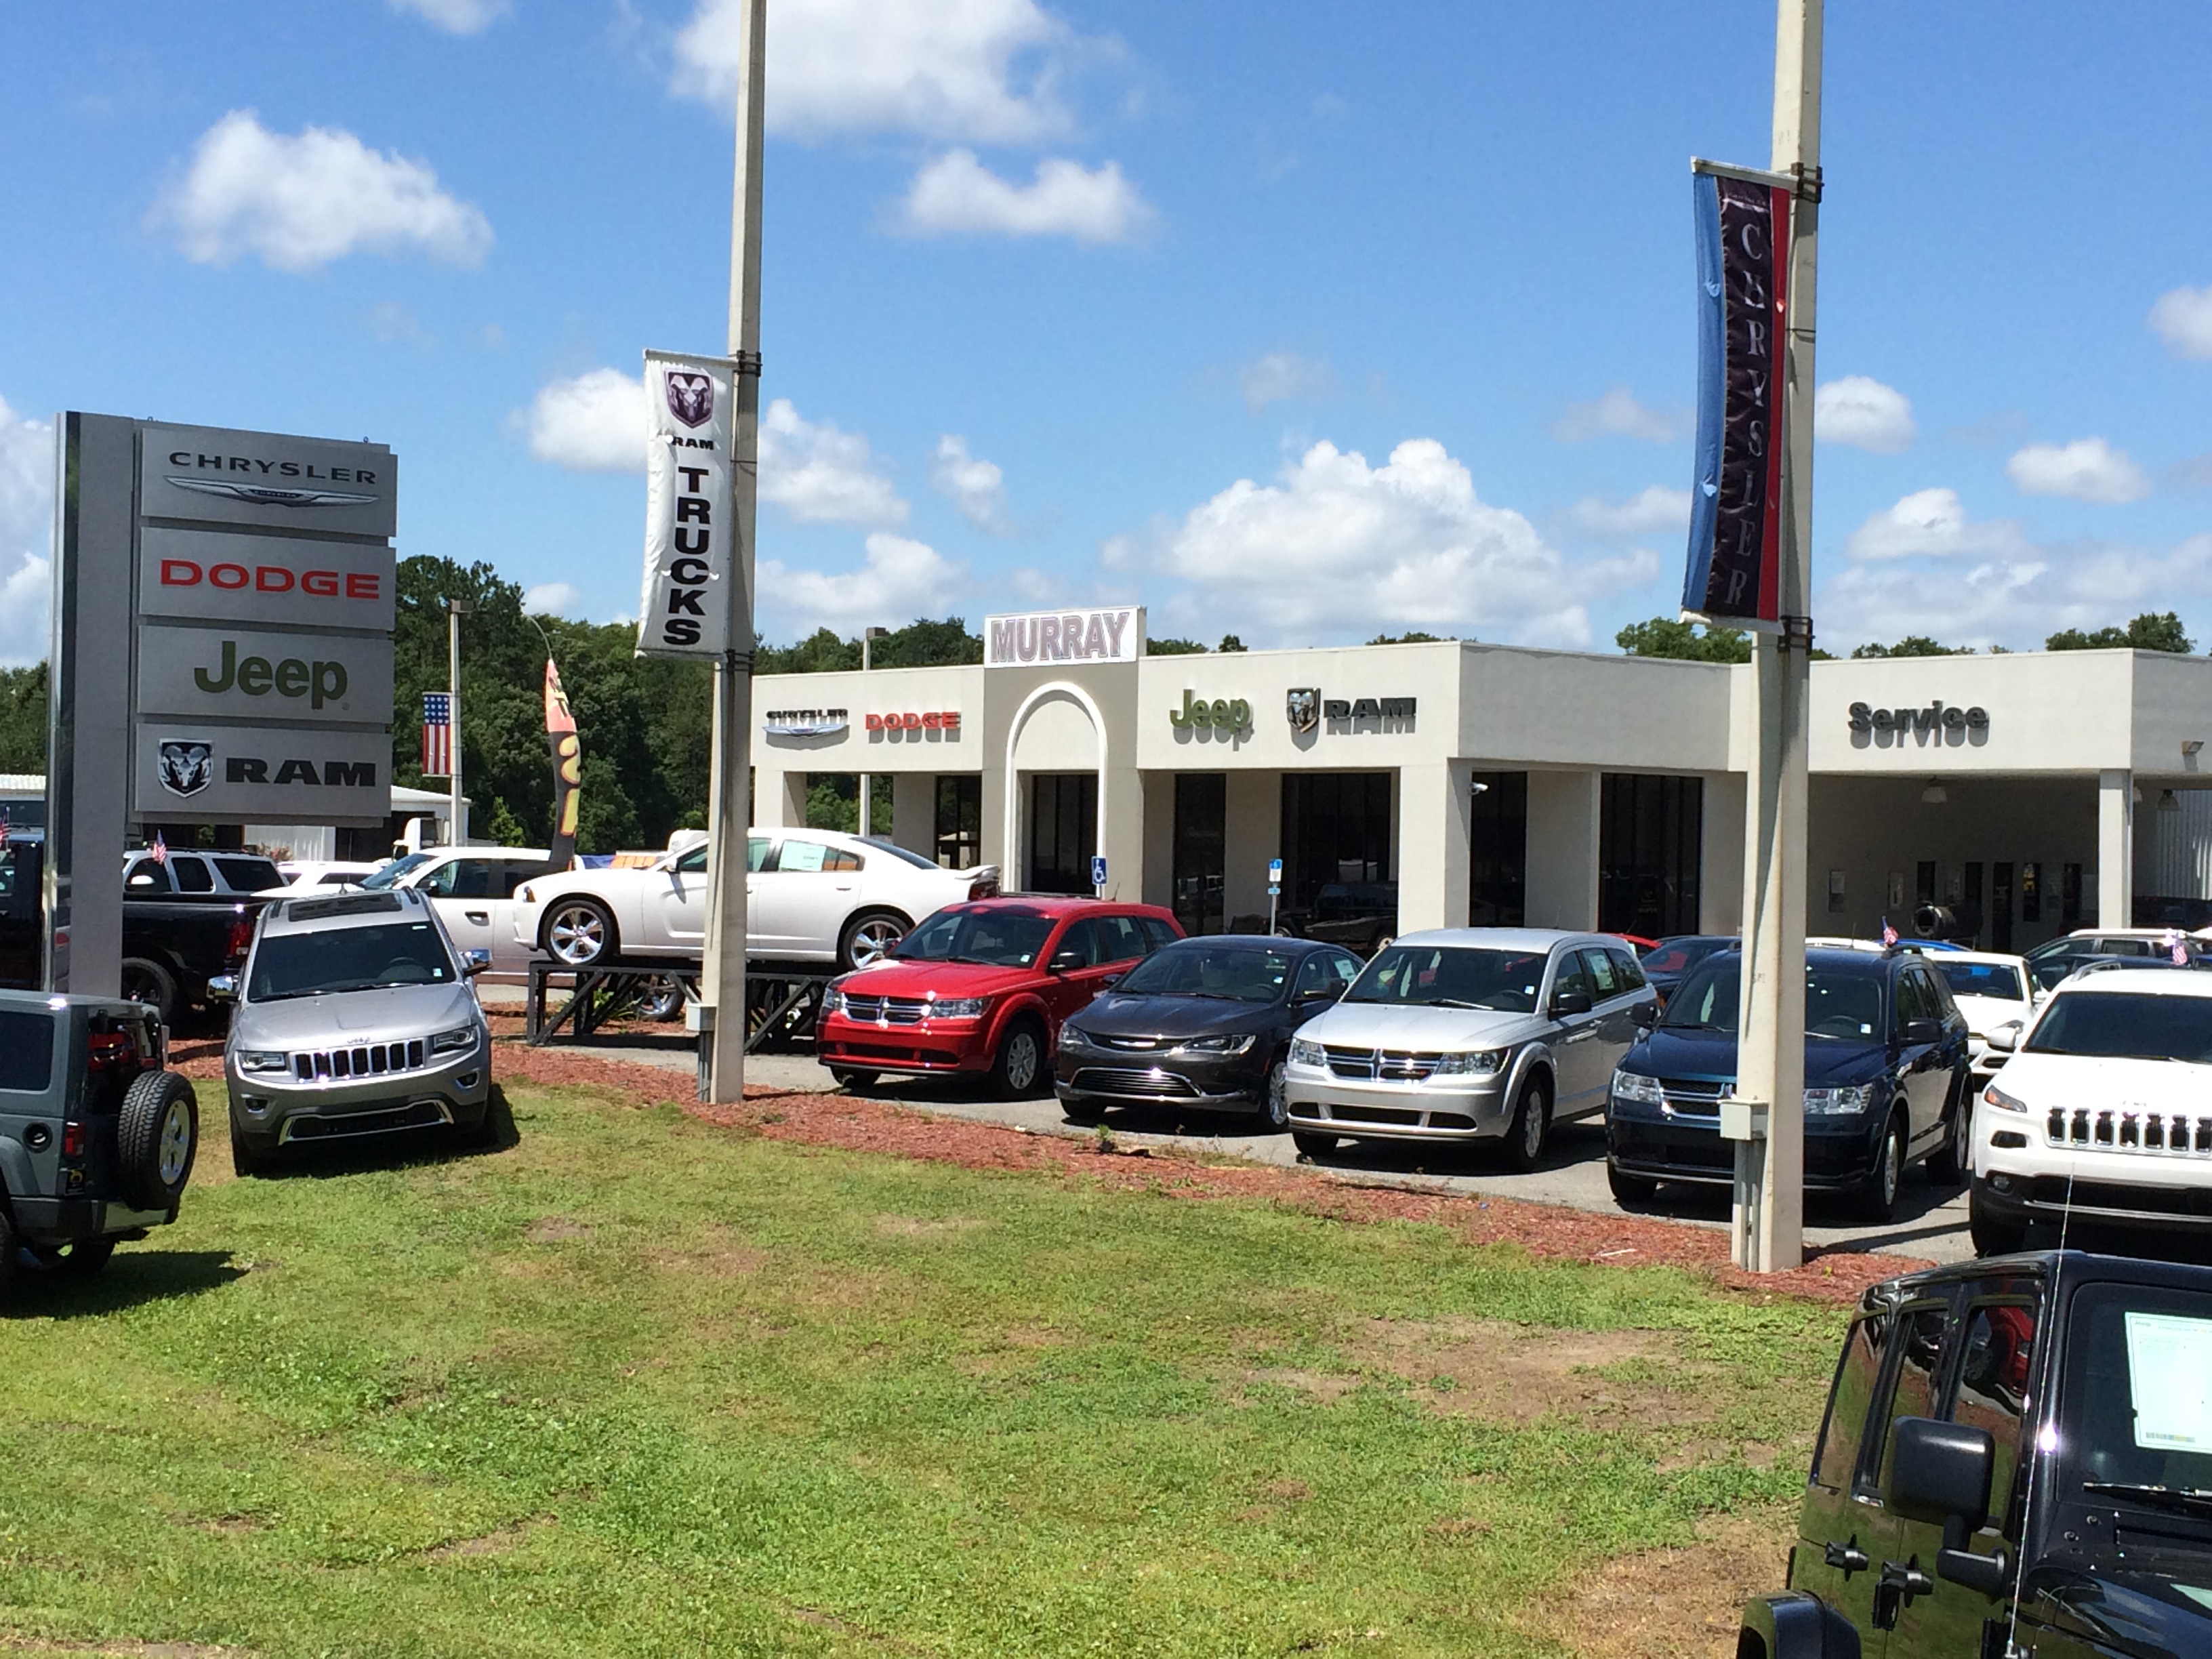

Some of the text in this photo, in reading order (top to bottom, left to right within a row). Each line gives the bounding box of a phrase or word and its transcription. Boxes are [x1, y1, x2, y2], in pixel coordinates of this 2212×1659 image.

[1726, 222, 1767, 605] CHRYSLER
[672, 435, 714, 451] RAM
[169, 451, 377, 485] CHRYSLER
[663, 466, 712, 646] TRUCKS
[160, 559, 380, 599] DODGE
[990, 611, 1130, 663] MURRAY
[194, 640, 348, 710] Jeep
[865, 712, 962, 731] DODGE
[1170, 689, 1252, 734] Jeep
[1324, 697, 1417, 719] RAM
[1847, 699, 1990, 732] Service
[226, 756, 377, 787] RAM
